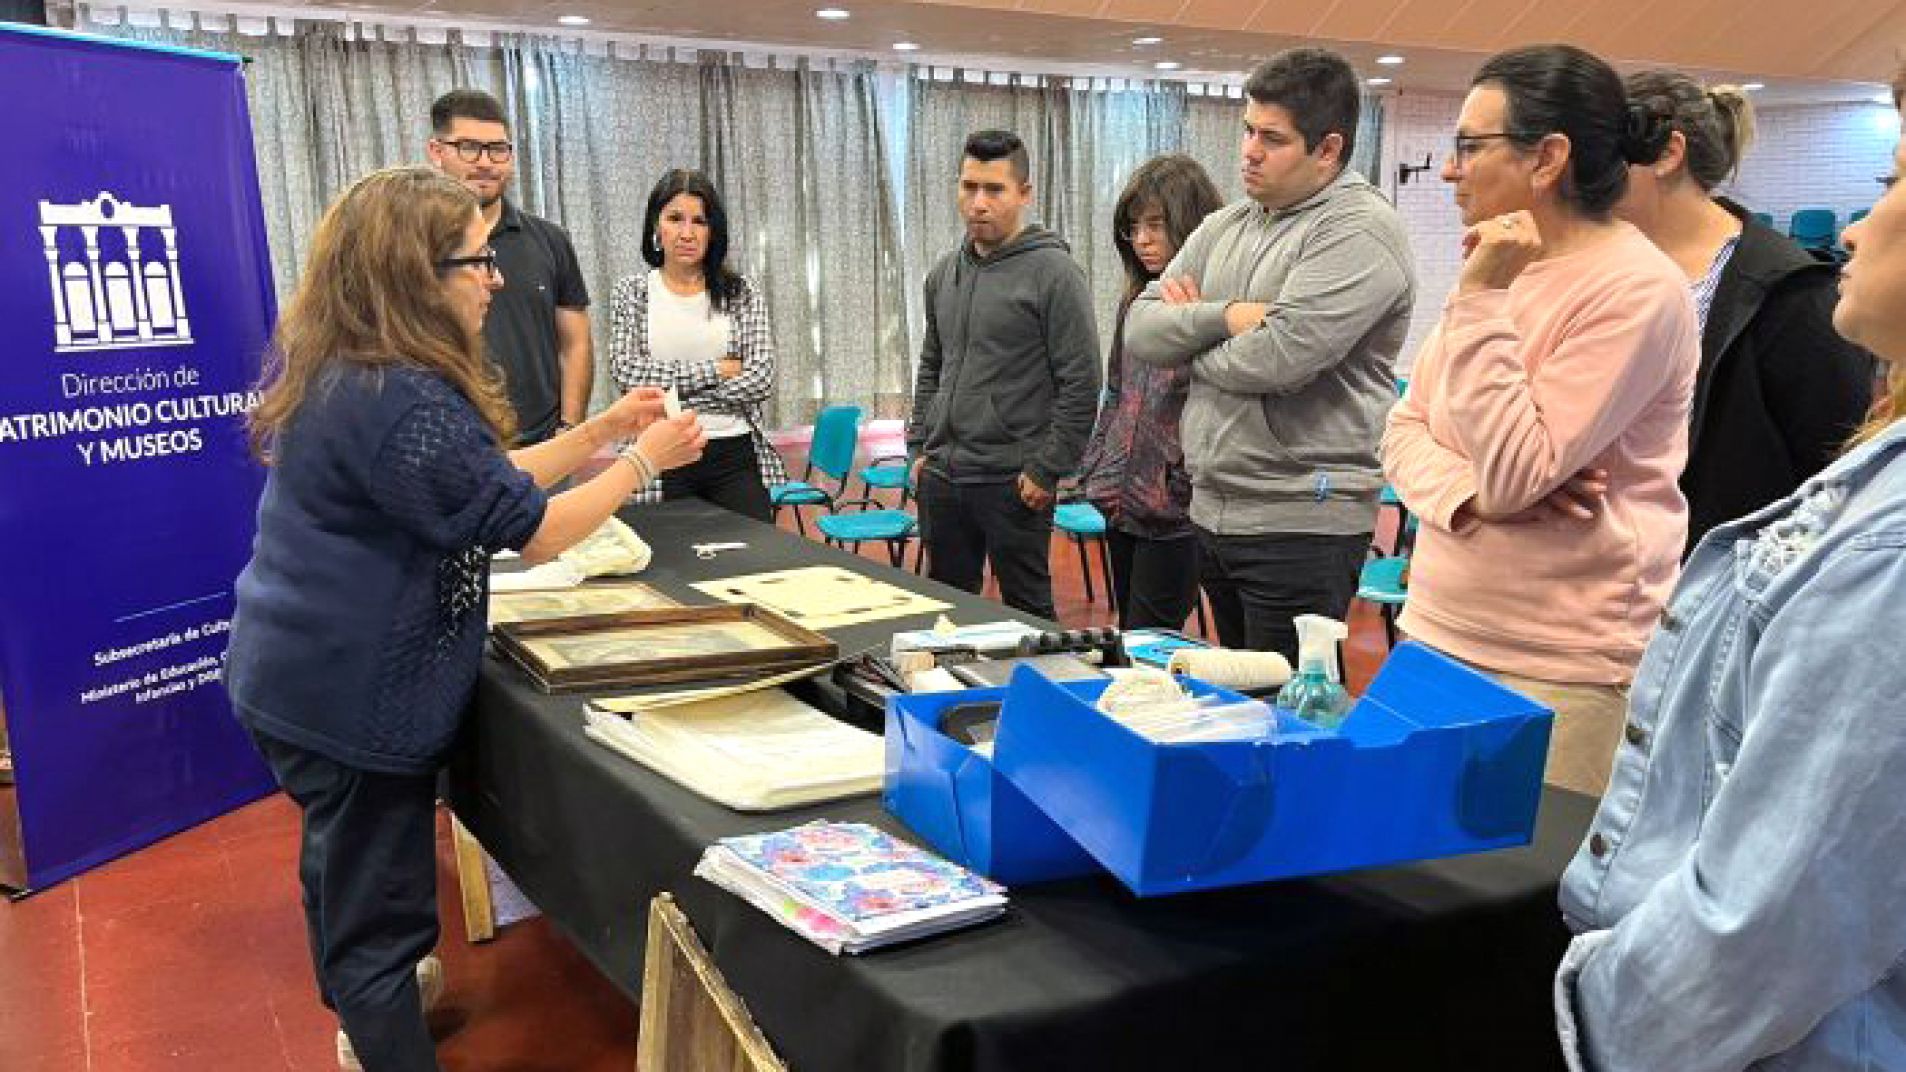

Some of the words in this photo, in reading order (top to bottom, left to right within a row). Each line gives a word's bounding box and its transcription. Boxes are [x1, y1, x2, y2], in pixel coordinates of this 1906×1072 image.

[61, 367, 170, 398] Dirección
[173, 365, 200, 387] de
[0, 403, 151, 442] ATRIMONIO
[76, 442, 94, 467] Y
[99, 428, 202, 464] MUSEOS
[185, 627, 200, 641] de
[81, 678, 141, 703] Ministerio
[144, 672, 159, 686] de
[187, 679, 194, 690] y
